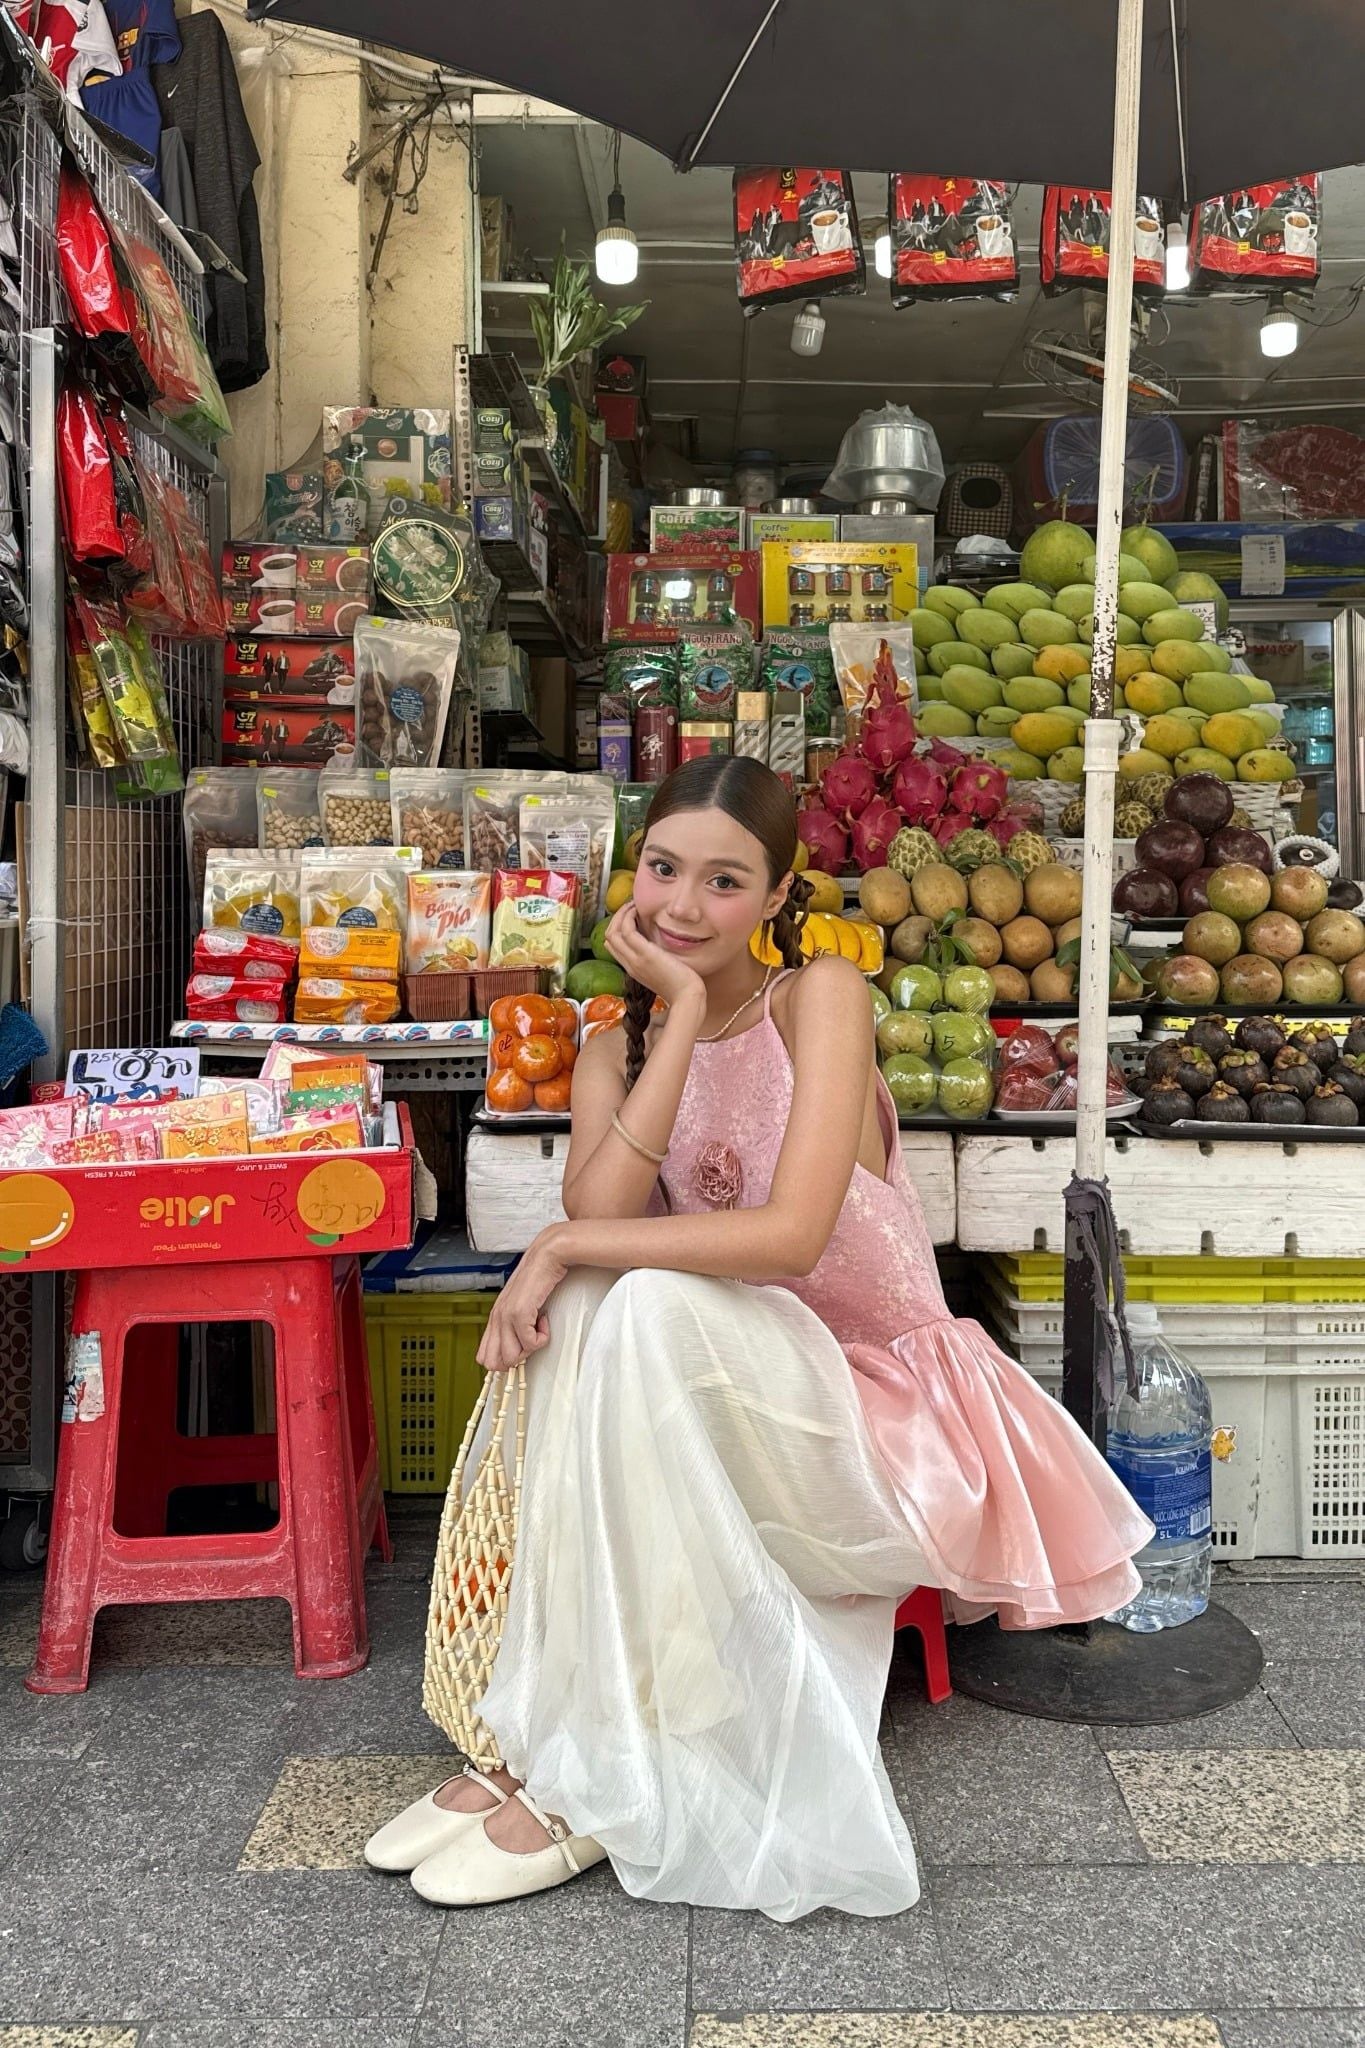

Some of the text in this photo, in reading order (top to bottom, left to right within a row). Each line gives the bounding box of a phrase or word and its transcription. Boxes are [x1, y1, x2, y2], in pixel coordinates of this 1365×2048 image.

[480, 415, 500, 424] Cozy
[480, 458, 500, 467] Cozy
[484, 505, 502, 513] Cozy
[658, 514, 696, 524] COFFEE
[760, 524, 789, 532] Coffee
[417, 617, 451, 629] OFFEE
[238, 643, 258, 654] G7
[236, 711, 257, 722] G7
[91, 1053, 120, 1064] 25K
[139, 1193, 236, 1227] Jolie
[152, 1241, 221, 1252] Premium Pear
